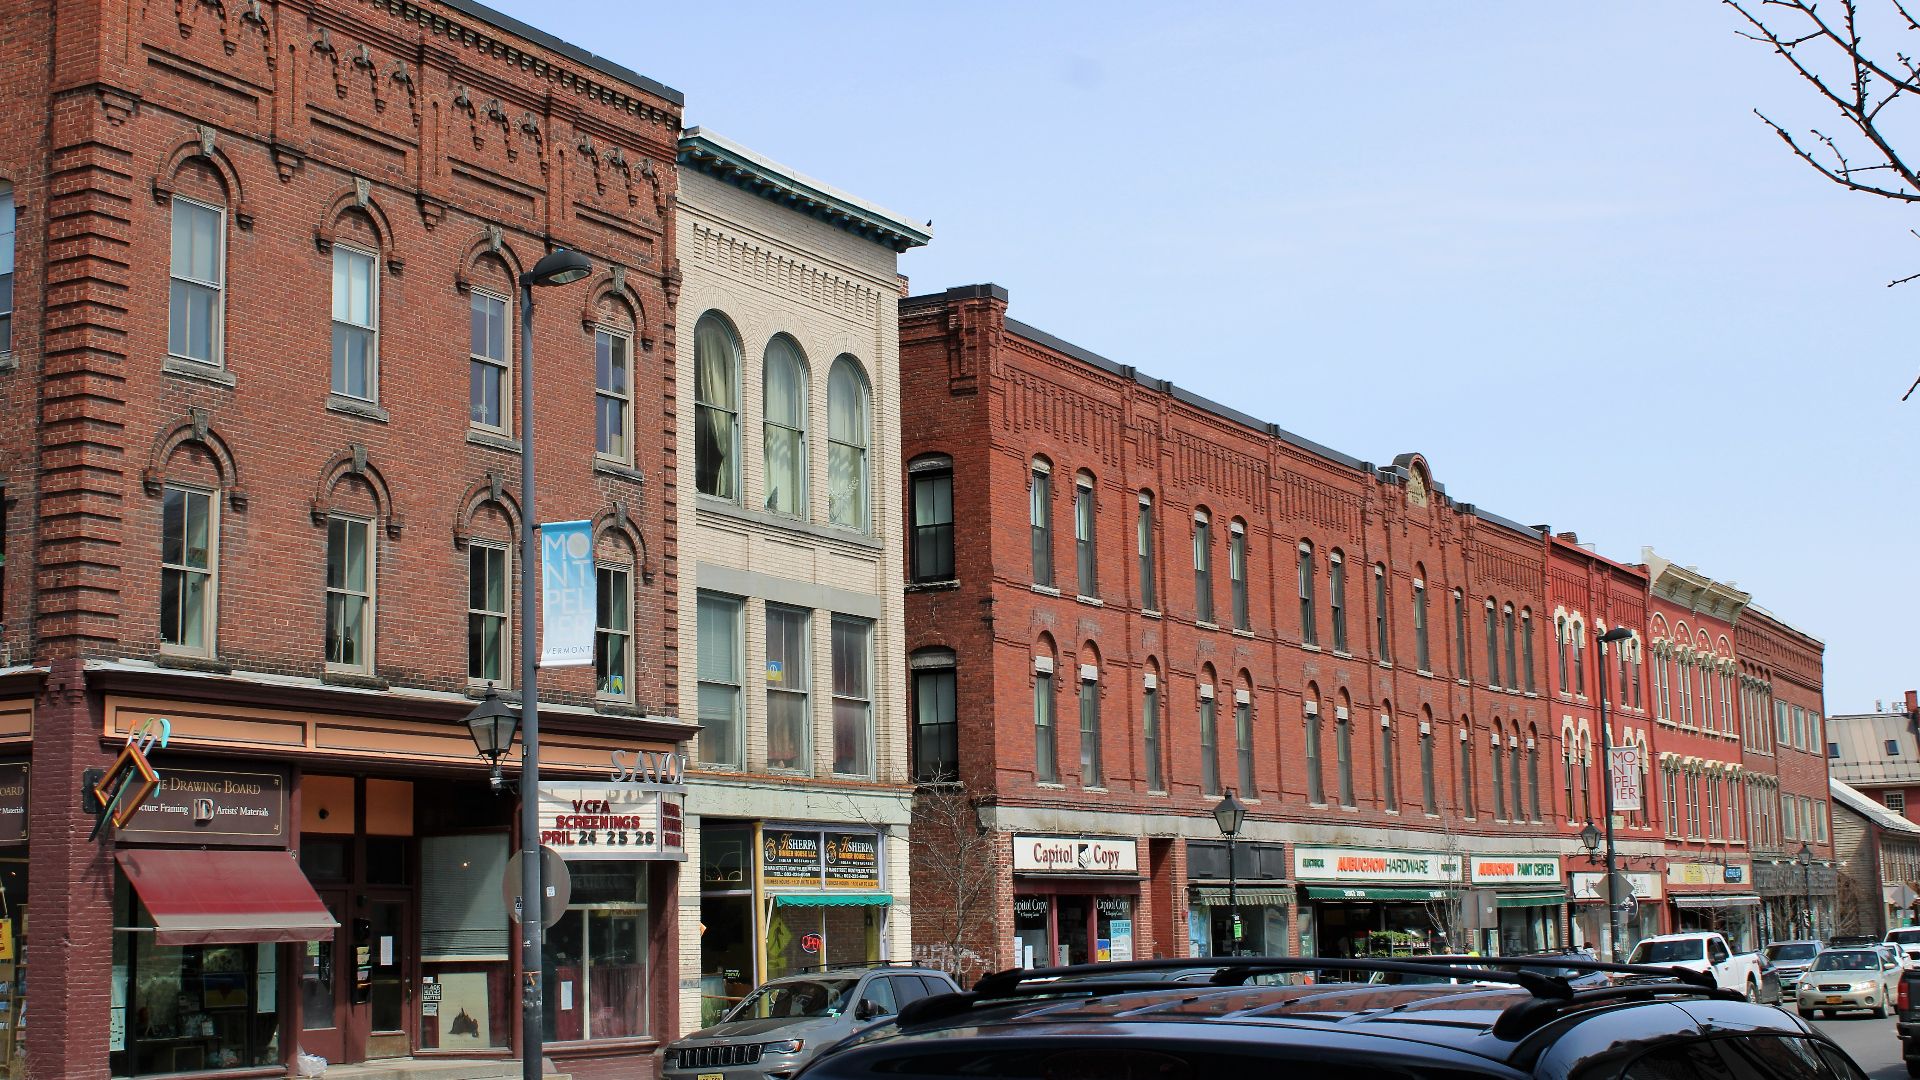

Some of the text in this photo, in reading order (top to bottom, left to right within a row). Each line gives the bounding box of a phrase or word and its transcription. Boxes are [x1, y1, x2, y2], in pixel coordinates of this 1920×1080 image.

[546, 645, 592, 655] VERMONT
[1614, 775, 1637, 788] PEL
[1616, 788, 1638, 800] IER
[160, 804, 189, 815] Framing
[240, 806, 269, 816] Materials
[572, 799, 611, 814] VCFA
[555, 815, 641, 830] SCREENINGS
[578, 830, 597, 845] 24
[606, 830, 629, 846] 25
[1033, 842, 1120, 870] Capitol Copy
[1337, 857, 1429, 874] AUBUCHON HARDWARE
[1478, 862, 1554, 876] AUBUCHON PAINT CENTER
[1014, 899, 1048, 913] apitol Copy
[802, 936, 821, 950] OPEN
